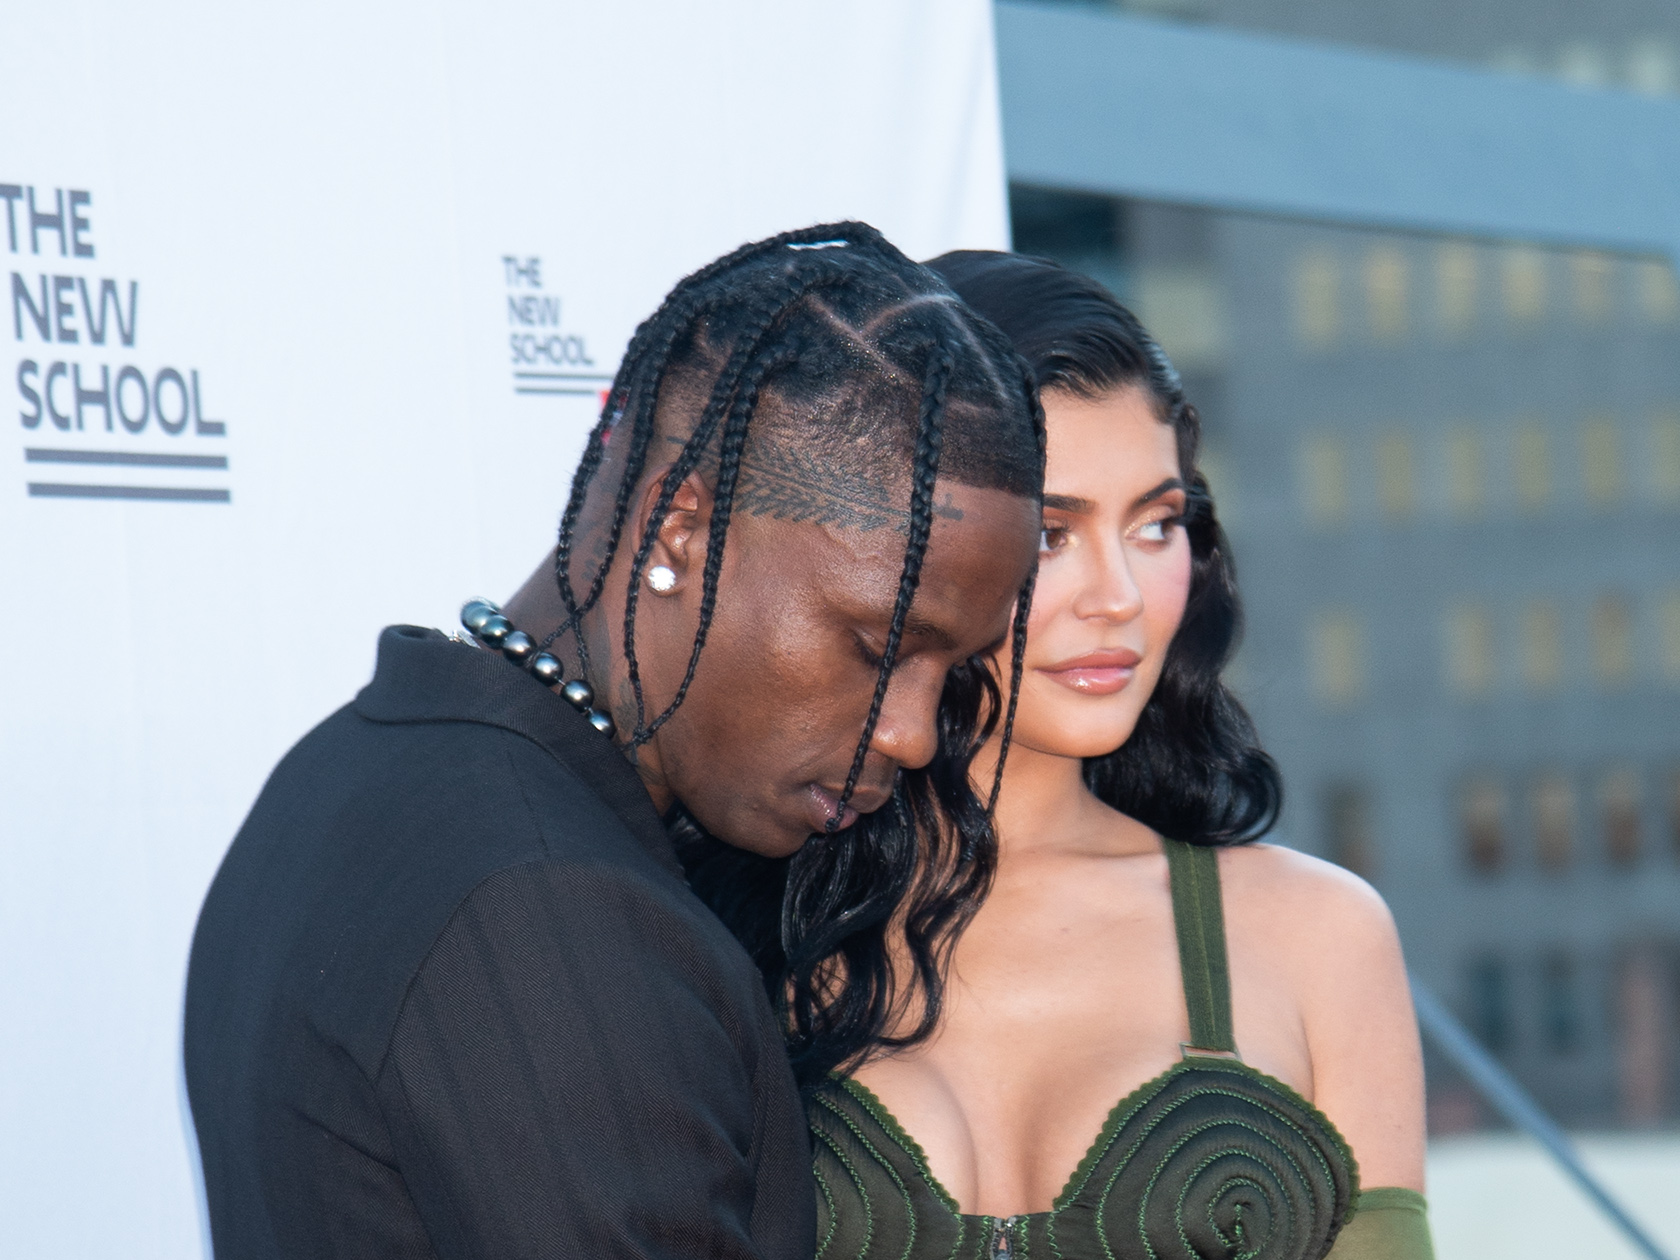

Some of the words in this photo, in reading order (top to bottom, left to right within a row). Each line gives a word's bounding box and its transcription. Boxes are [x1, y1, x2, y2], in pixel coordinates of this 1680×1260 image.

[0, 182, 96, 260] THE
[502, 255, 543, 288] THE
[9, 271, 139, 349] NEW
[507, 295, 560, 327] NEW
[511, 333, 594, 367] SCHOOL
[16, 358, 228, 438] SCHOOL
